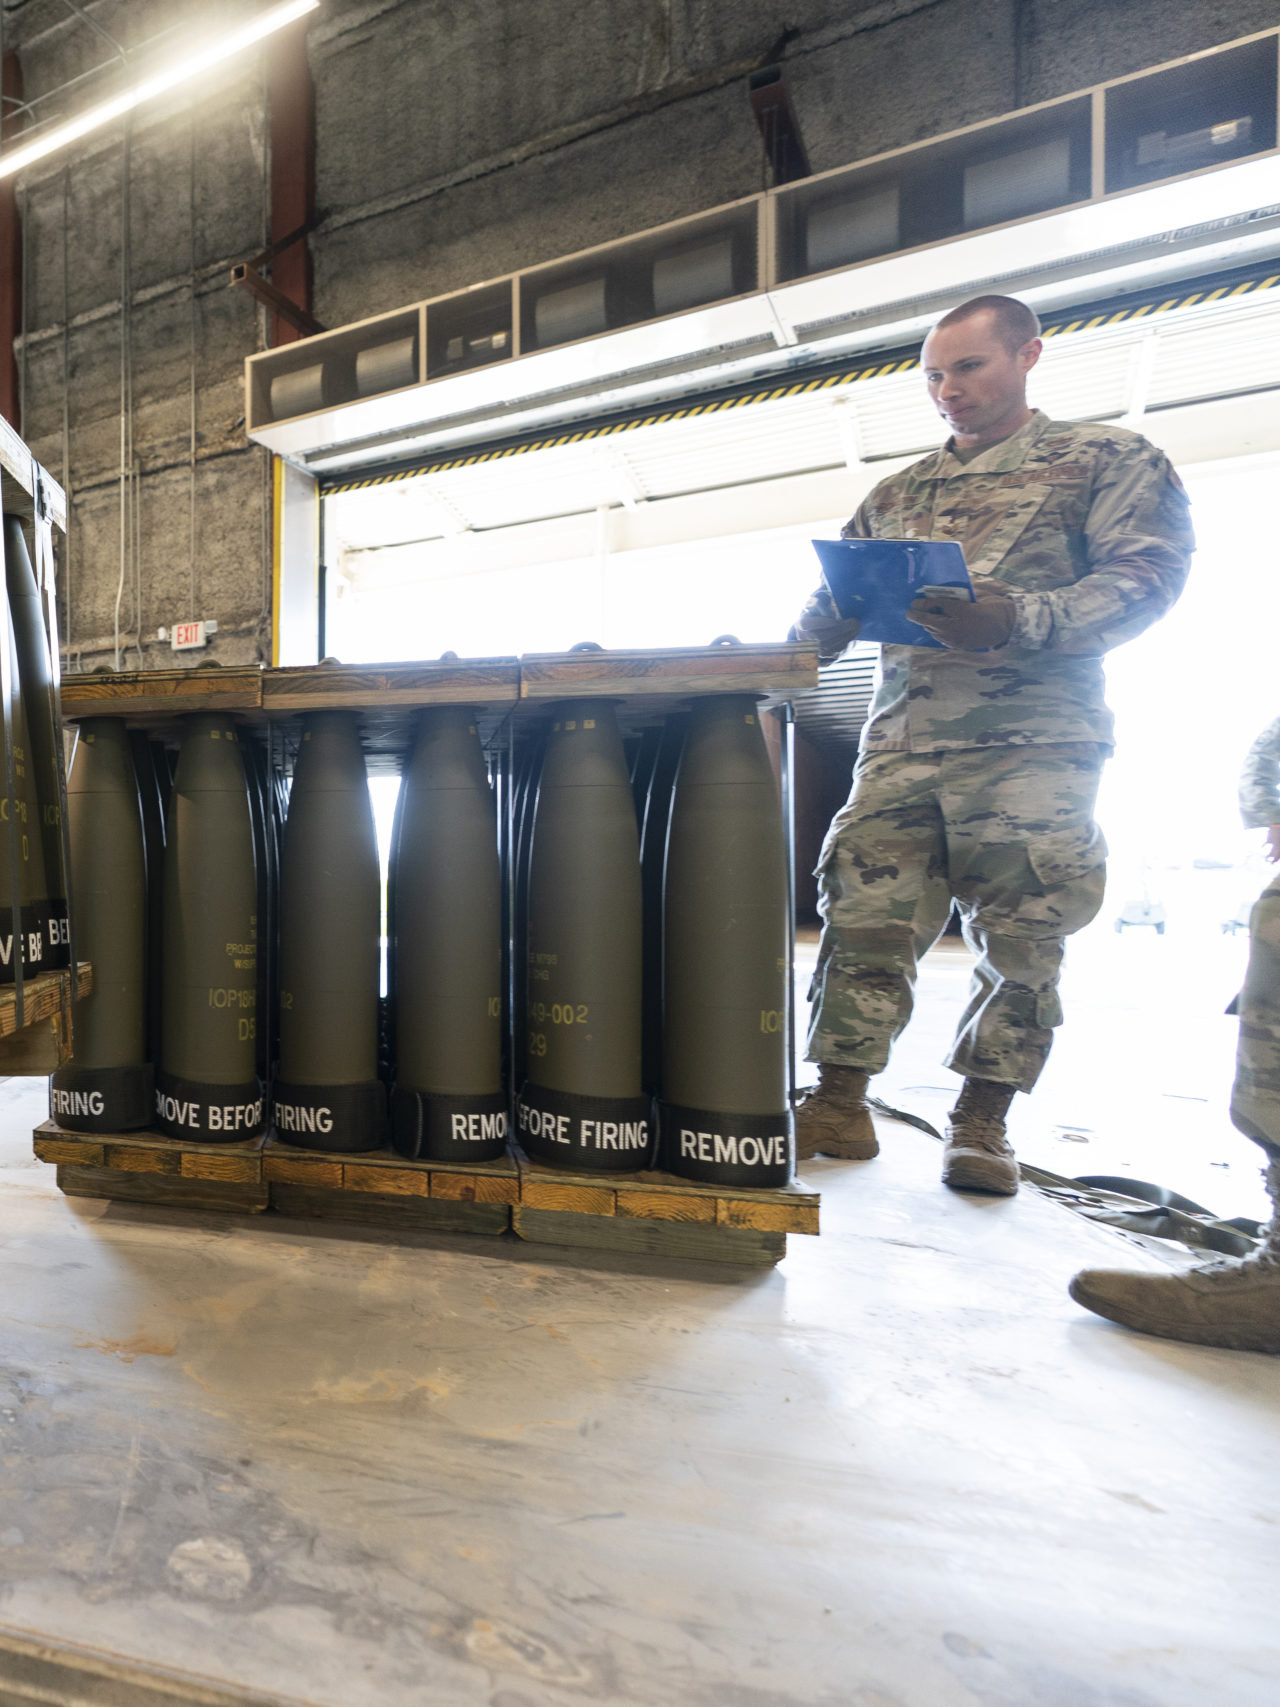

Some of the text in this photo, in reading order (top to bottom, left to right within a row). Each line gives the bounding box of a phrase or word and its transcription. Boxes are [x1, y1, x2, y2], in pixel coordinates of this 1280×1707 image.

[177, 623, 199, 645] EXIT
[52, 1088, 105, 1116] FIRING
[580, 1119, 648, 1150] FIRING
[681, 1129, 786, 1166] REMOVE
